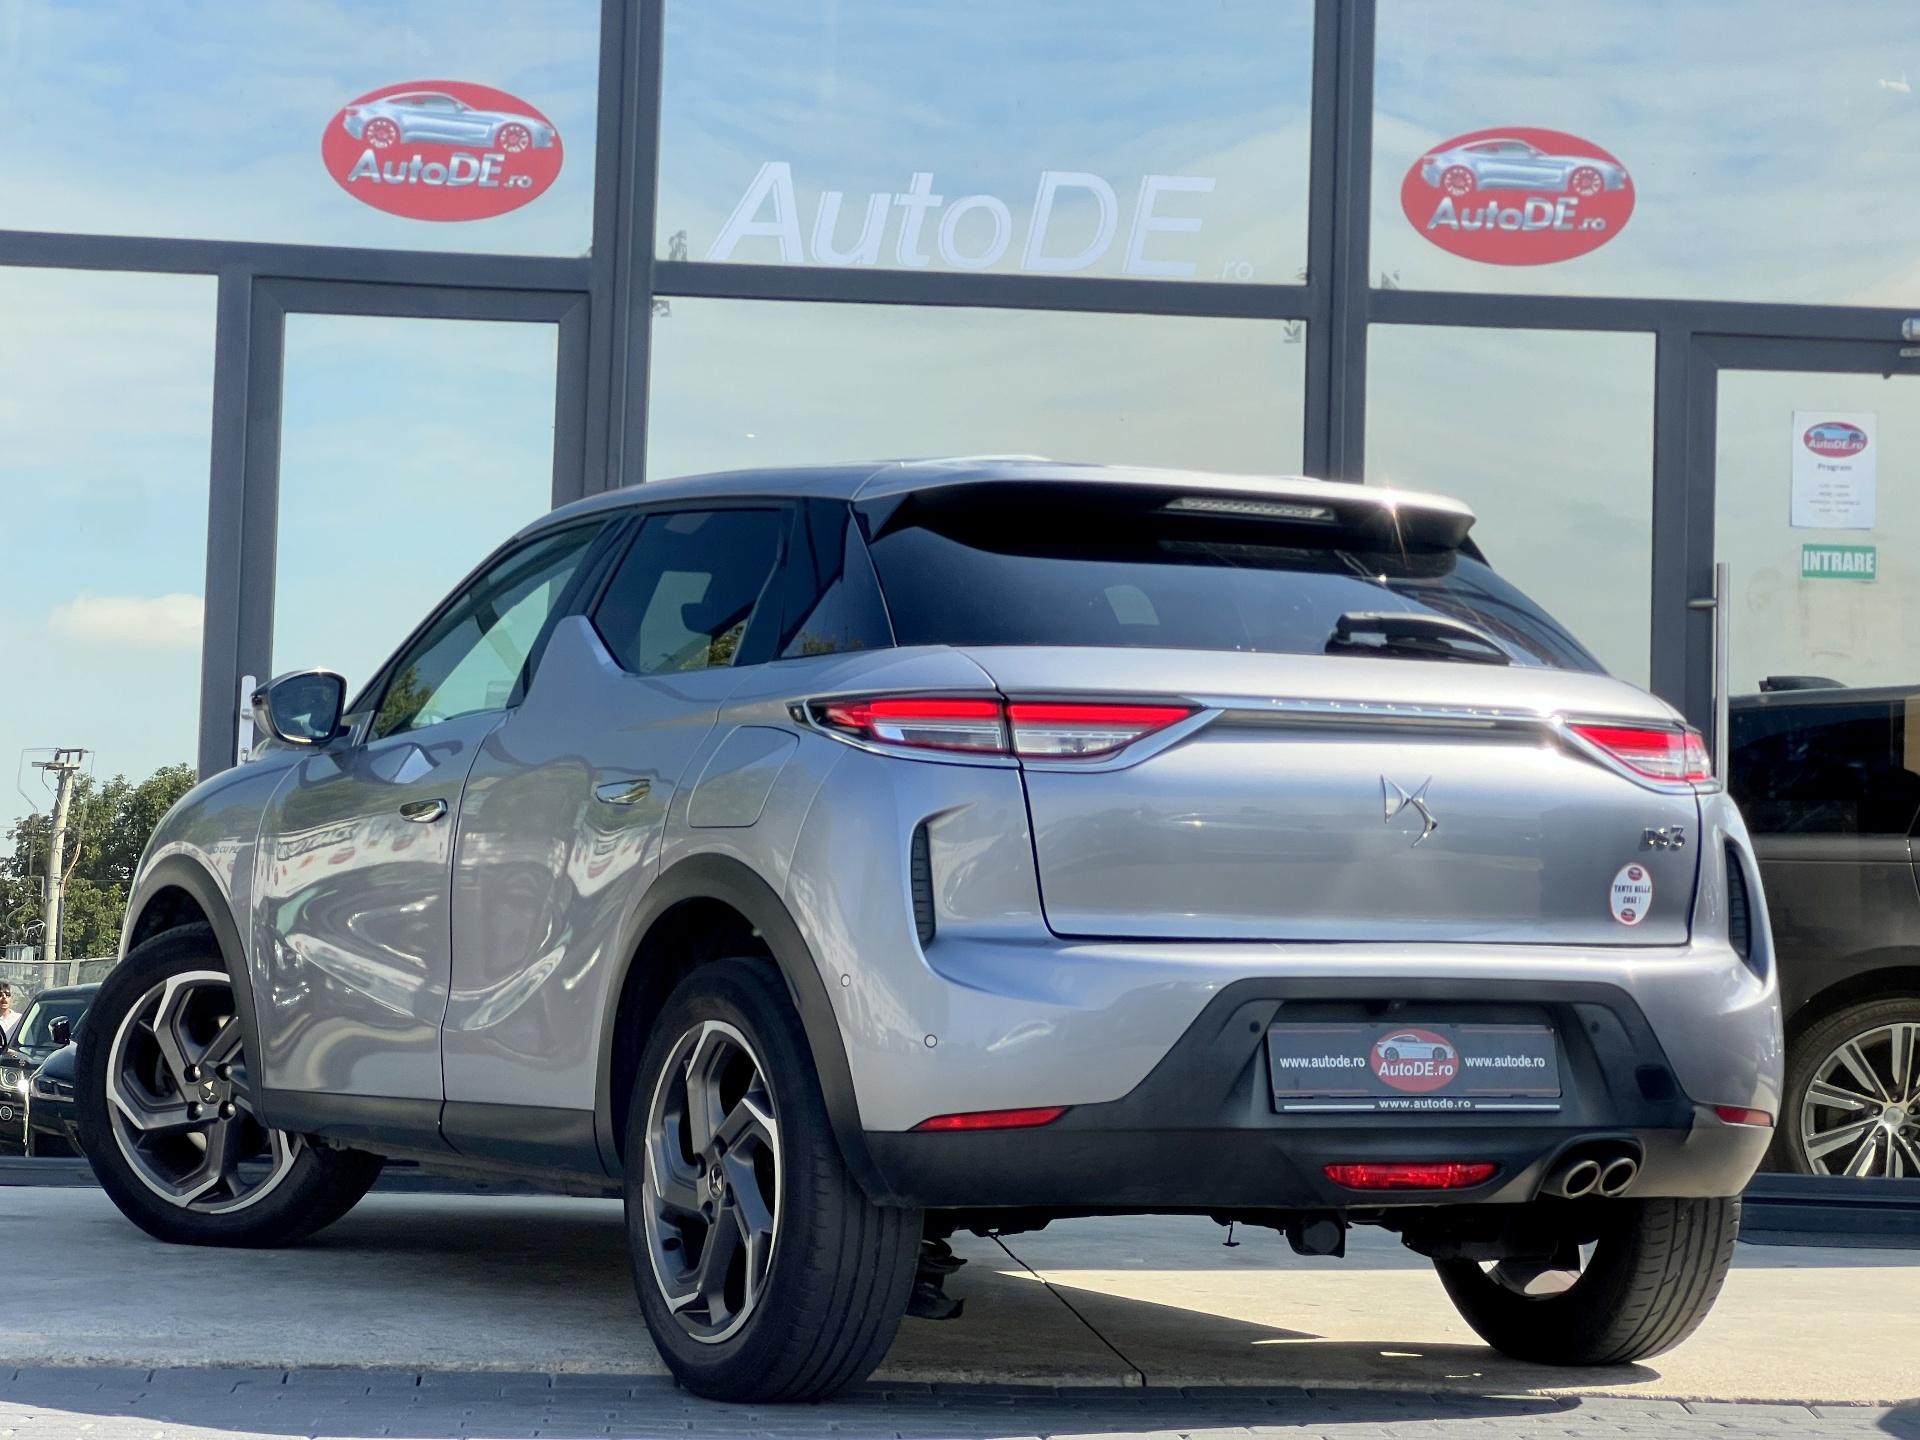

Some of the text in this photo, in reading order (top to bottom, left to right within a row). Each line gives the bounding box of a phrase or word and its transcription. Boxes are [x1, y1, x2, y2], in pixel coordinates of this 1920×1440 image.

[1803, 550, 1875, 573] INTRARE
[1280, 1055, 1546, 1077] www.autode.ro AutoDE.ro www.autode.ro
[1378, 1098, 1471, 1109] www.autode.ro
